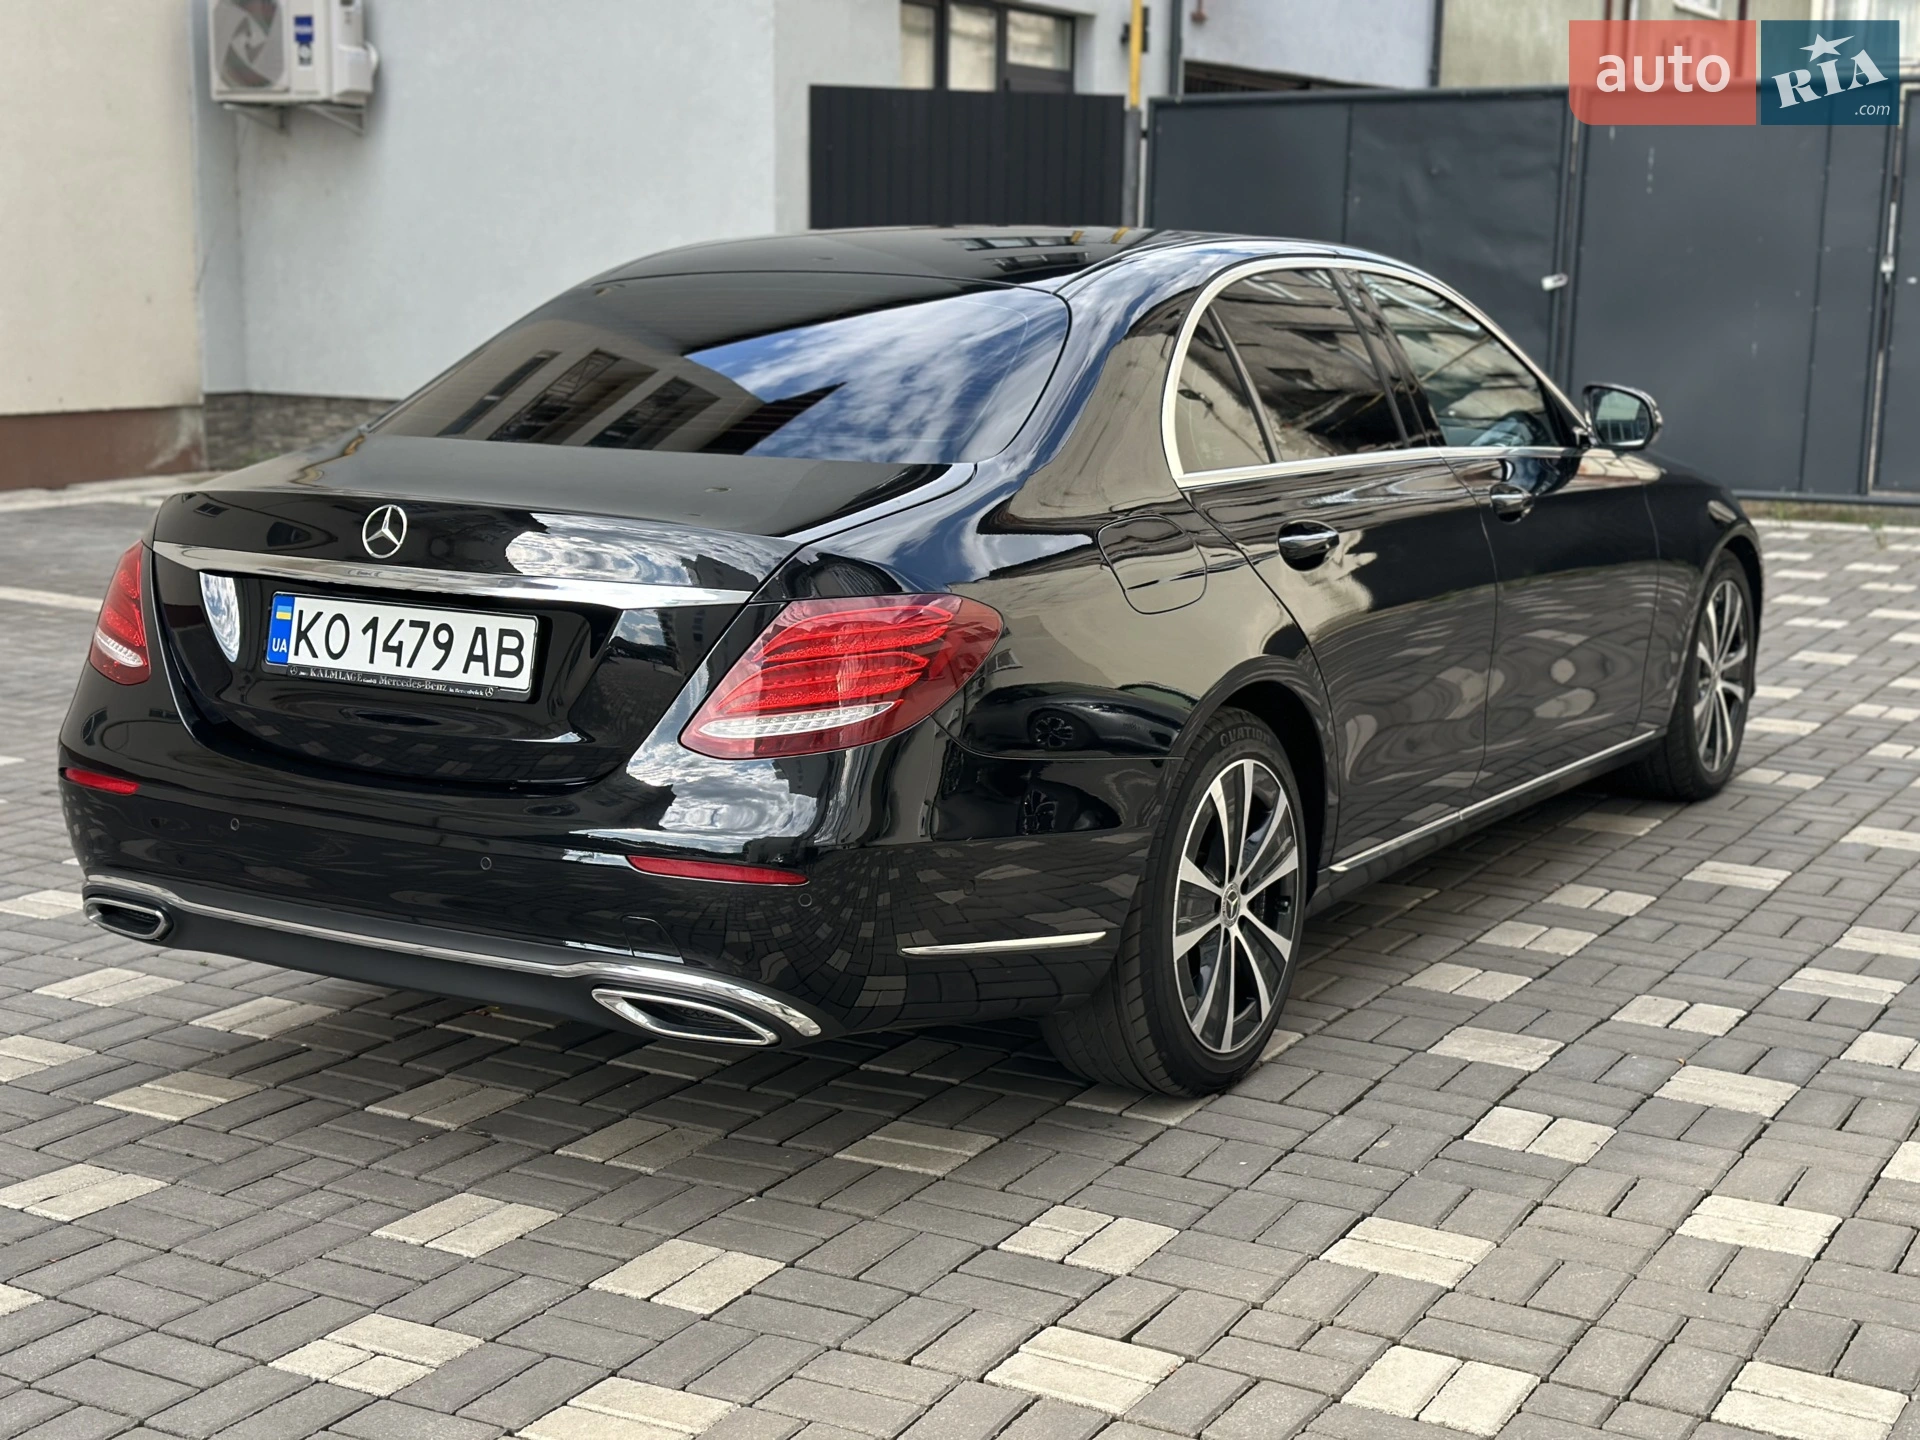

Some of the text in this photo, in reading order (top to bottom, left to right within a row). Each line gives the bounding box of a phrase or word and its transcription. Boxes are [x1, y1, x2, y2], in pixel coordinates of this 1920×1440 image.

[271, 637, 288, 653] UA
[293, 609, 525, 679] KO 1479 AB
[378, 675, 448, 692] Mercedes-Benz
